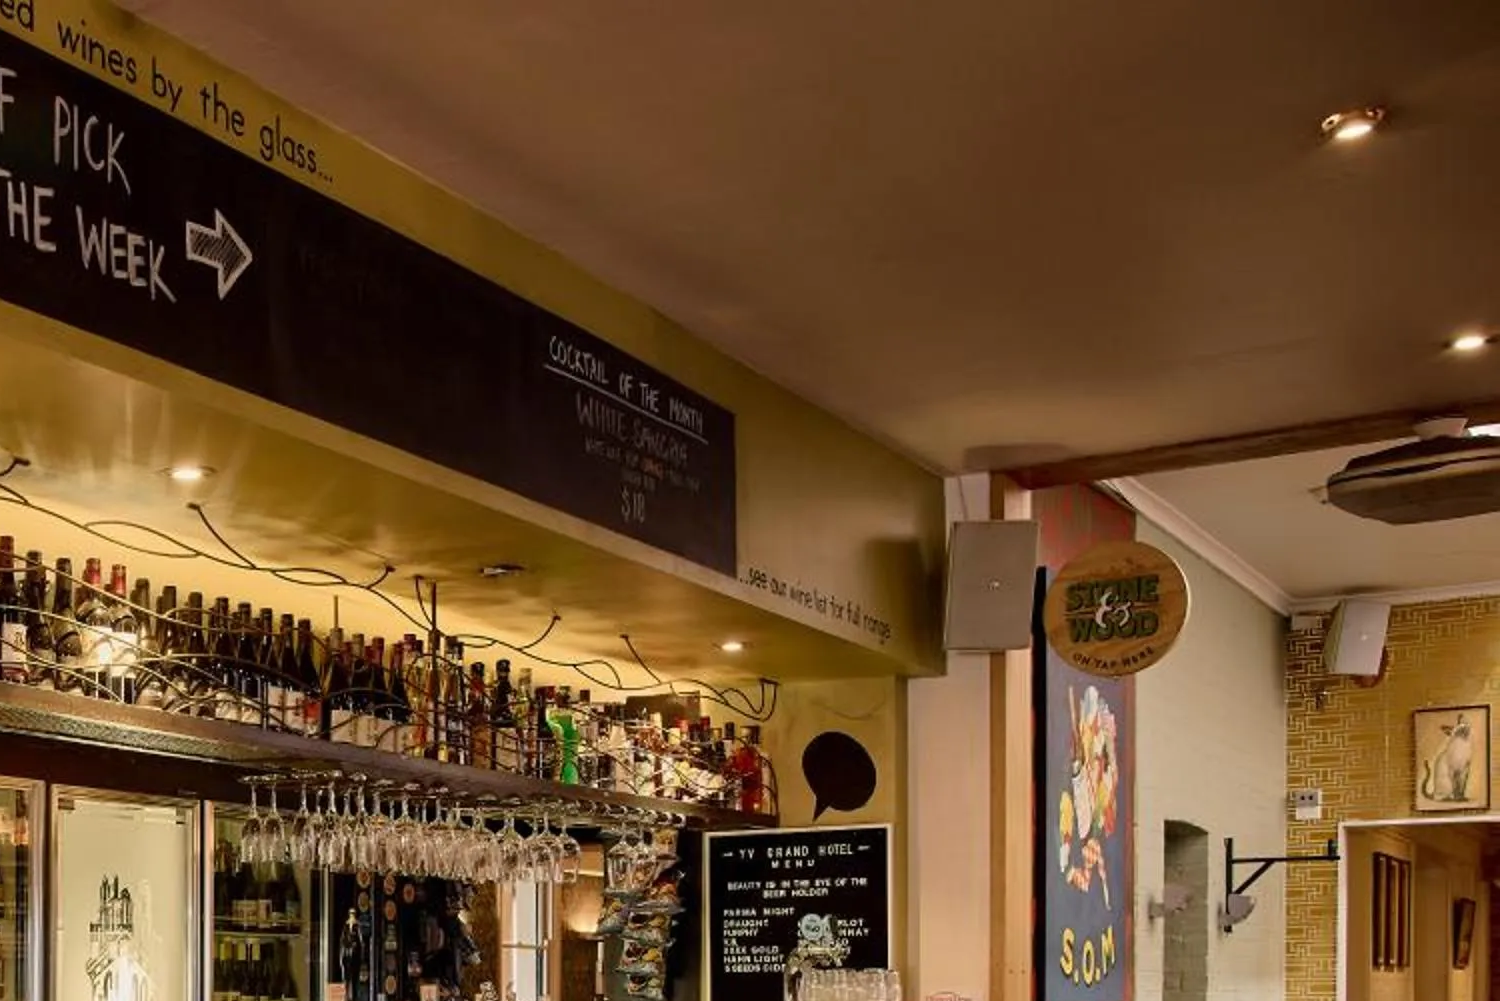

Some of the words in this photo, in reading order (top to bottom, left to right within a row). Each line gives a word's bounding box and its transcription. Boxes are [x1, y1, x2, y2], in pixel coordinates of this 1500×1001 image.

[57, 19, 137, 84] wines
[152, 57, 183, 112] by
[200, 82, 245, 137] the
[259, 115, 333, 183] glass...
[54, 95, 131, 195] PICK
[76, 204, 176, 303] WEEK
[549, 335, 609, 384] COCKTAIL
[619, 371, 634, 398] OF
[640, 382, 660, 413] THE
[669, 398, 703, 433] MONTH
[1066, 574, 1160, 610] STONE
[770, 577, 787, 596] our
[830, 595, 844, 619] for
[863, 614, 892, 645] range
[1068, 610, 1160, 643] WOOD
[1073, 653, 1090, 665] ON
[1093, 659, 1117, 669] TAP
[1122, 646, 1155, 667] HERE
[767, 845, 809, 859] GRAND
[818, 843, 854, 856] HOTEL
[727, 881, 762, 891] BEAUTY
[765, 880, 777, 889] IS
[781, 880, 791, 888] IN
[794, 879, 810, 888] THE
[815, 878, 831, 887] EYE
[835, 877, 847, 886] OF
[851, 877, 868, 886] THE
[763, 889, 787, 899] BEER
[791, 888, 829, 897] HOLDER
[763, 907, 795, 915] NIGHT
[753, 954, 785, 963] LIGHT
